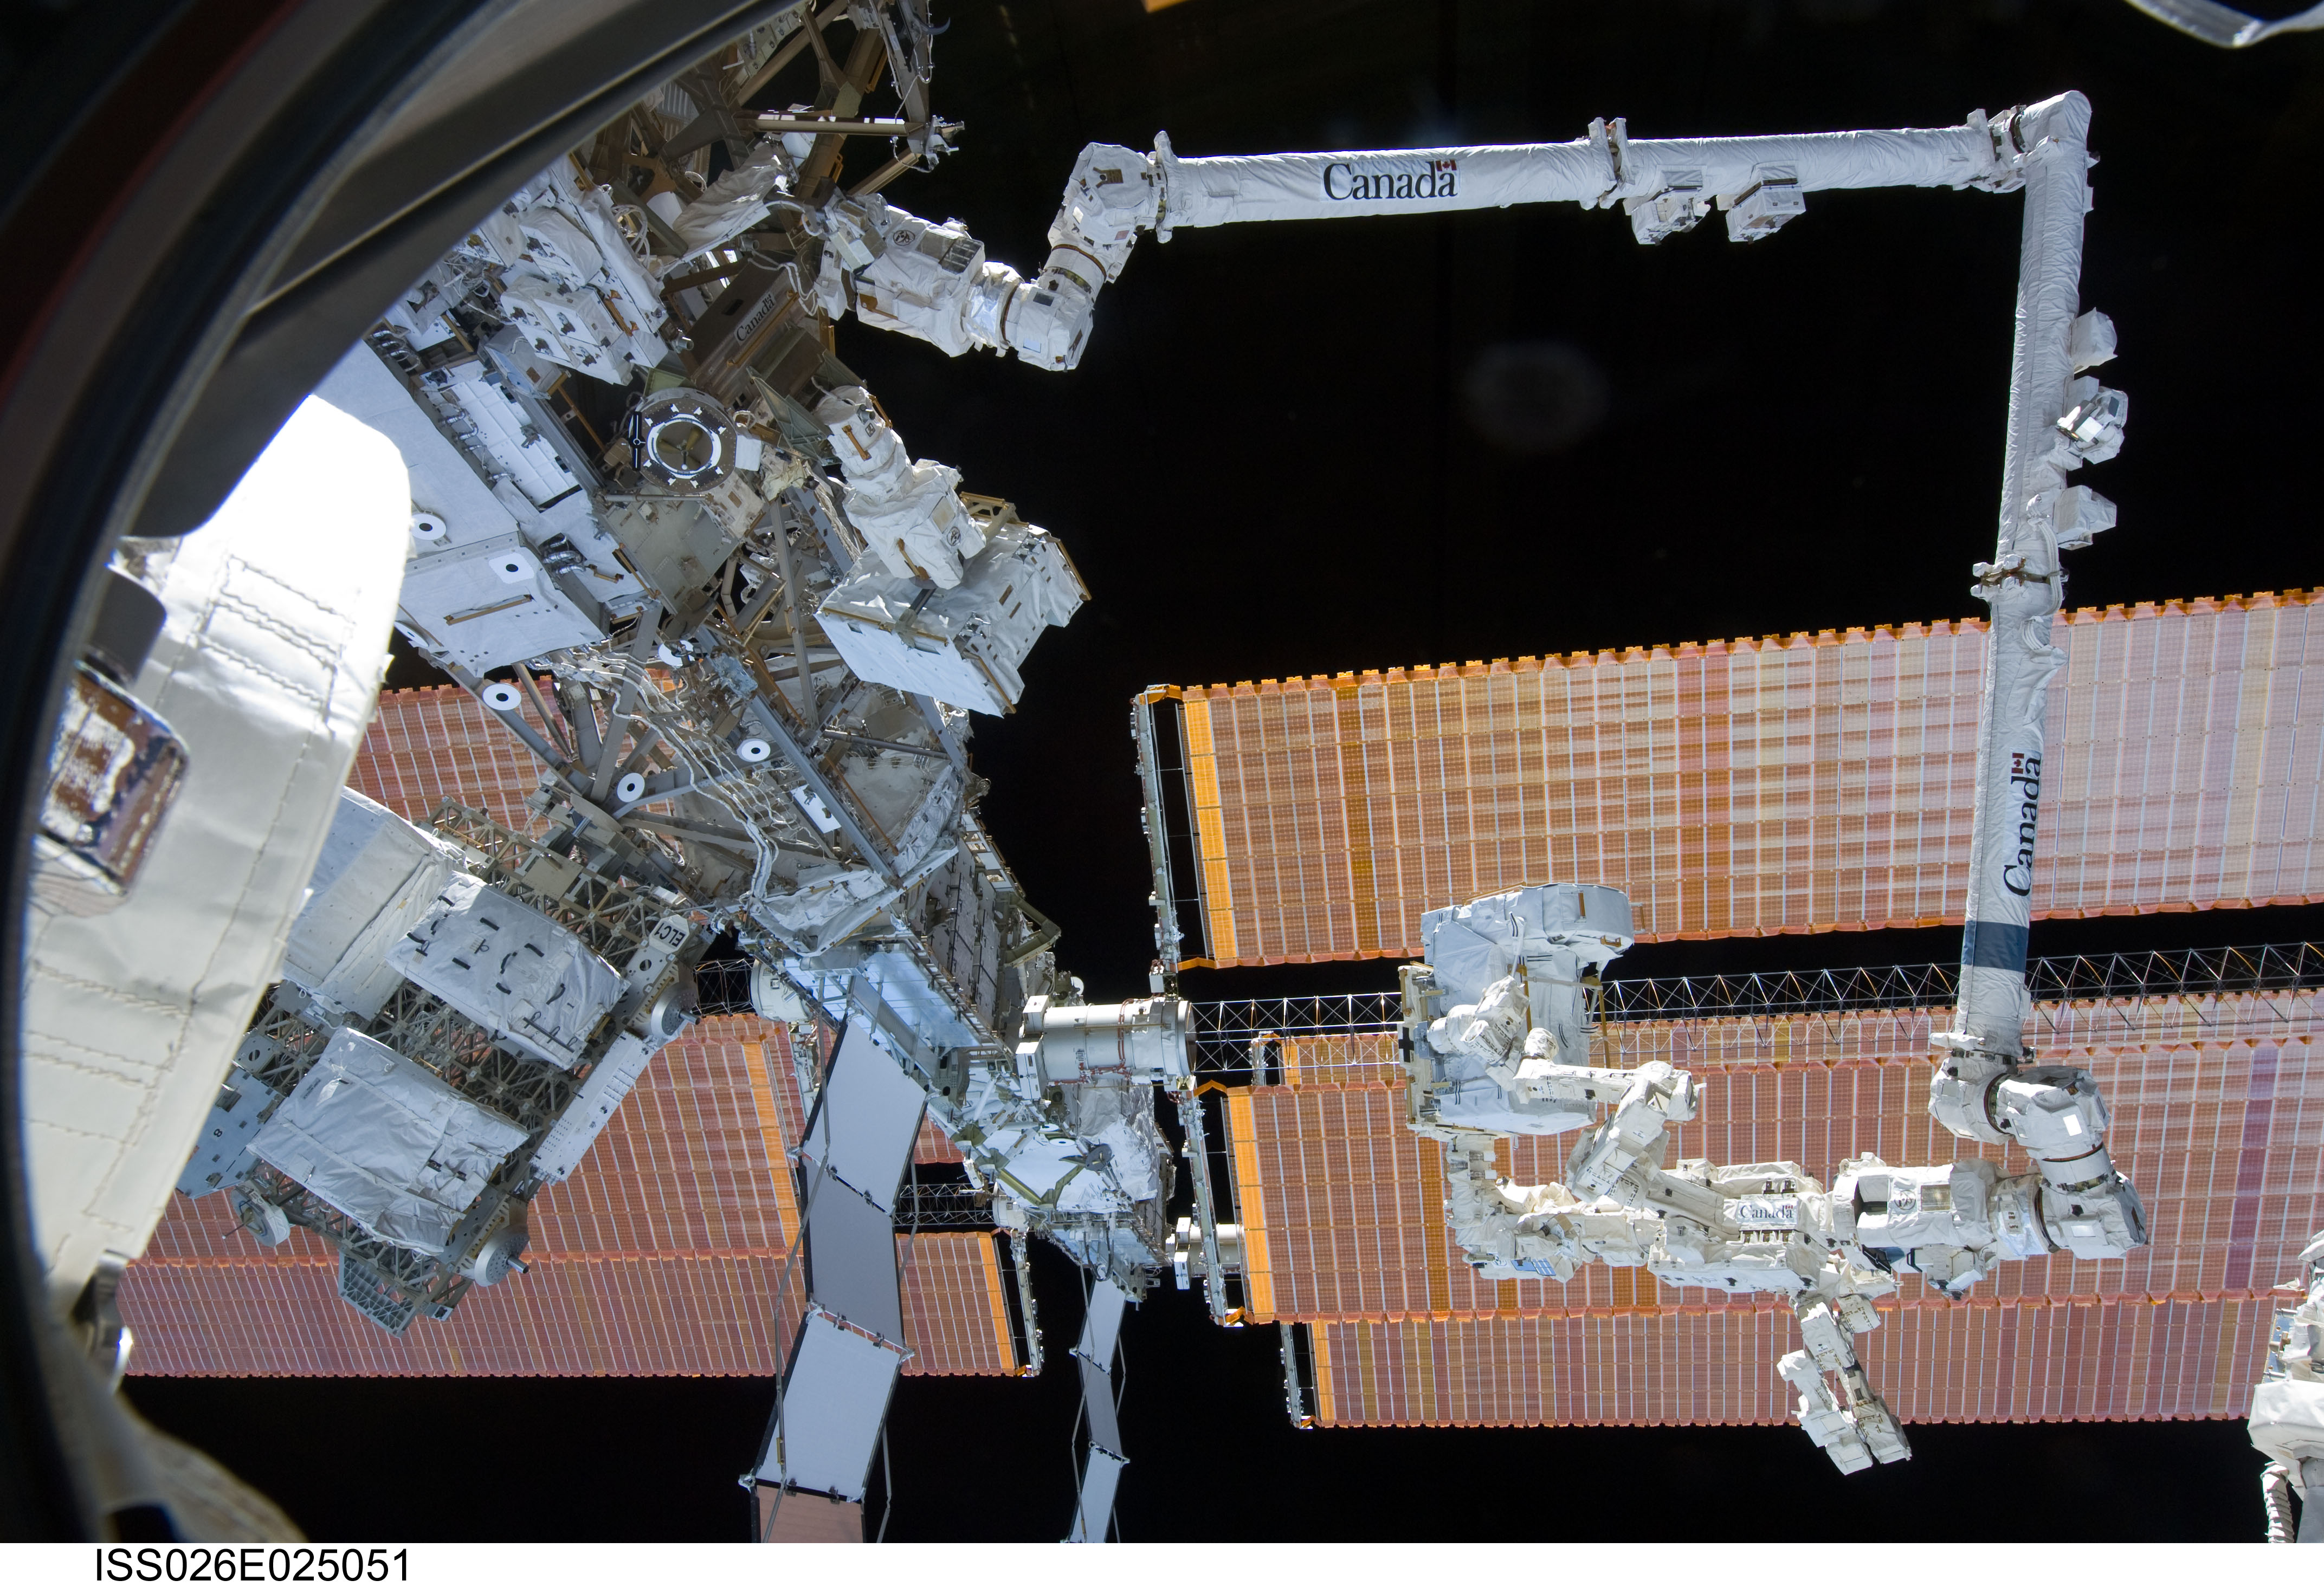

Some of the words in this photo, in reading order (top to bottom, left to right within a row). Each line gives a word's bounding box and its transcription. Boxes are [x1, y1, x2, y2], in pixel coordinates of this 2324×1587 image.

[1324, 161, 1458, 200] Canada
[736, 299, 775, 341] Canada
[2004, 755, 2042, 896] Canada
[654, 923, 686, 947] ELC1
[214, 1129, 222, 1137] 8
[1740, 1205, 1793, 1219] Canada
